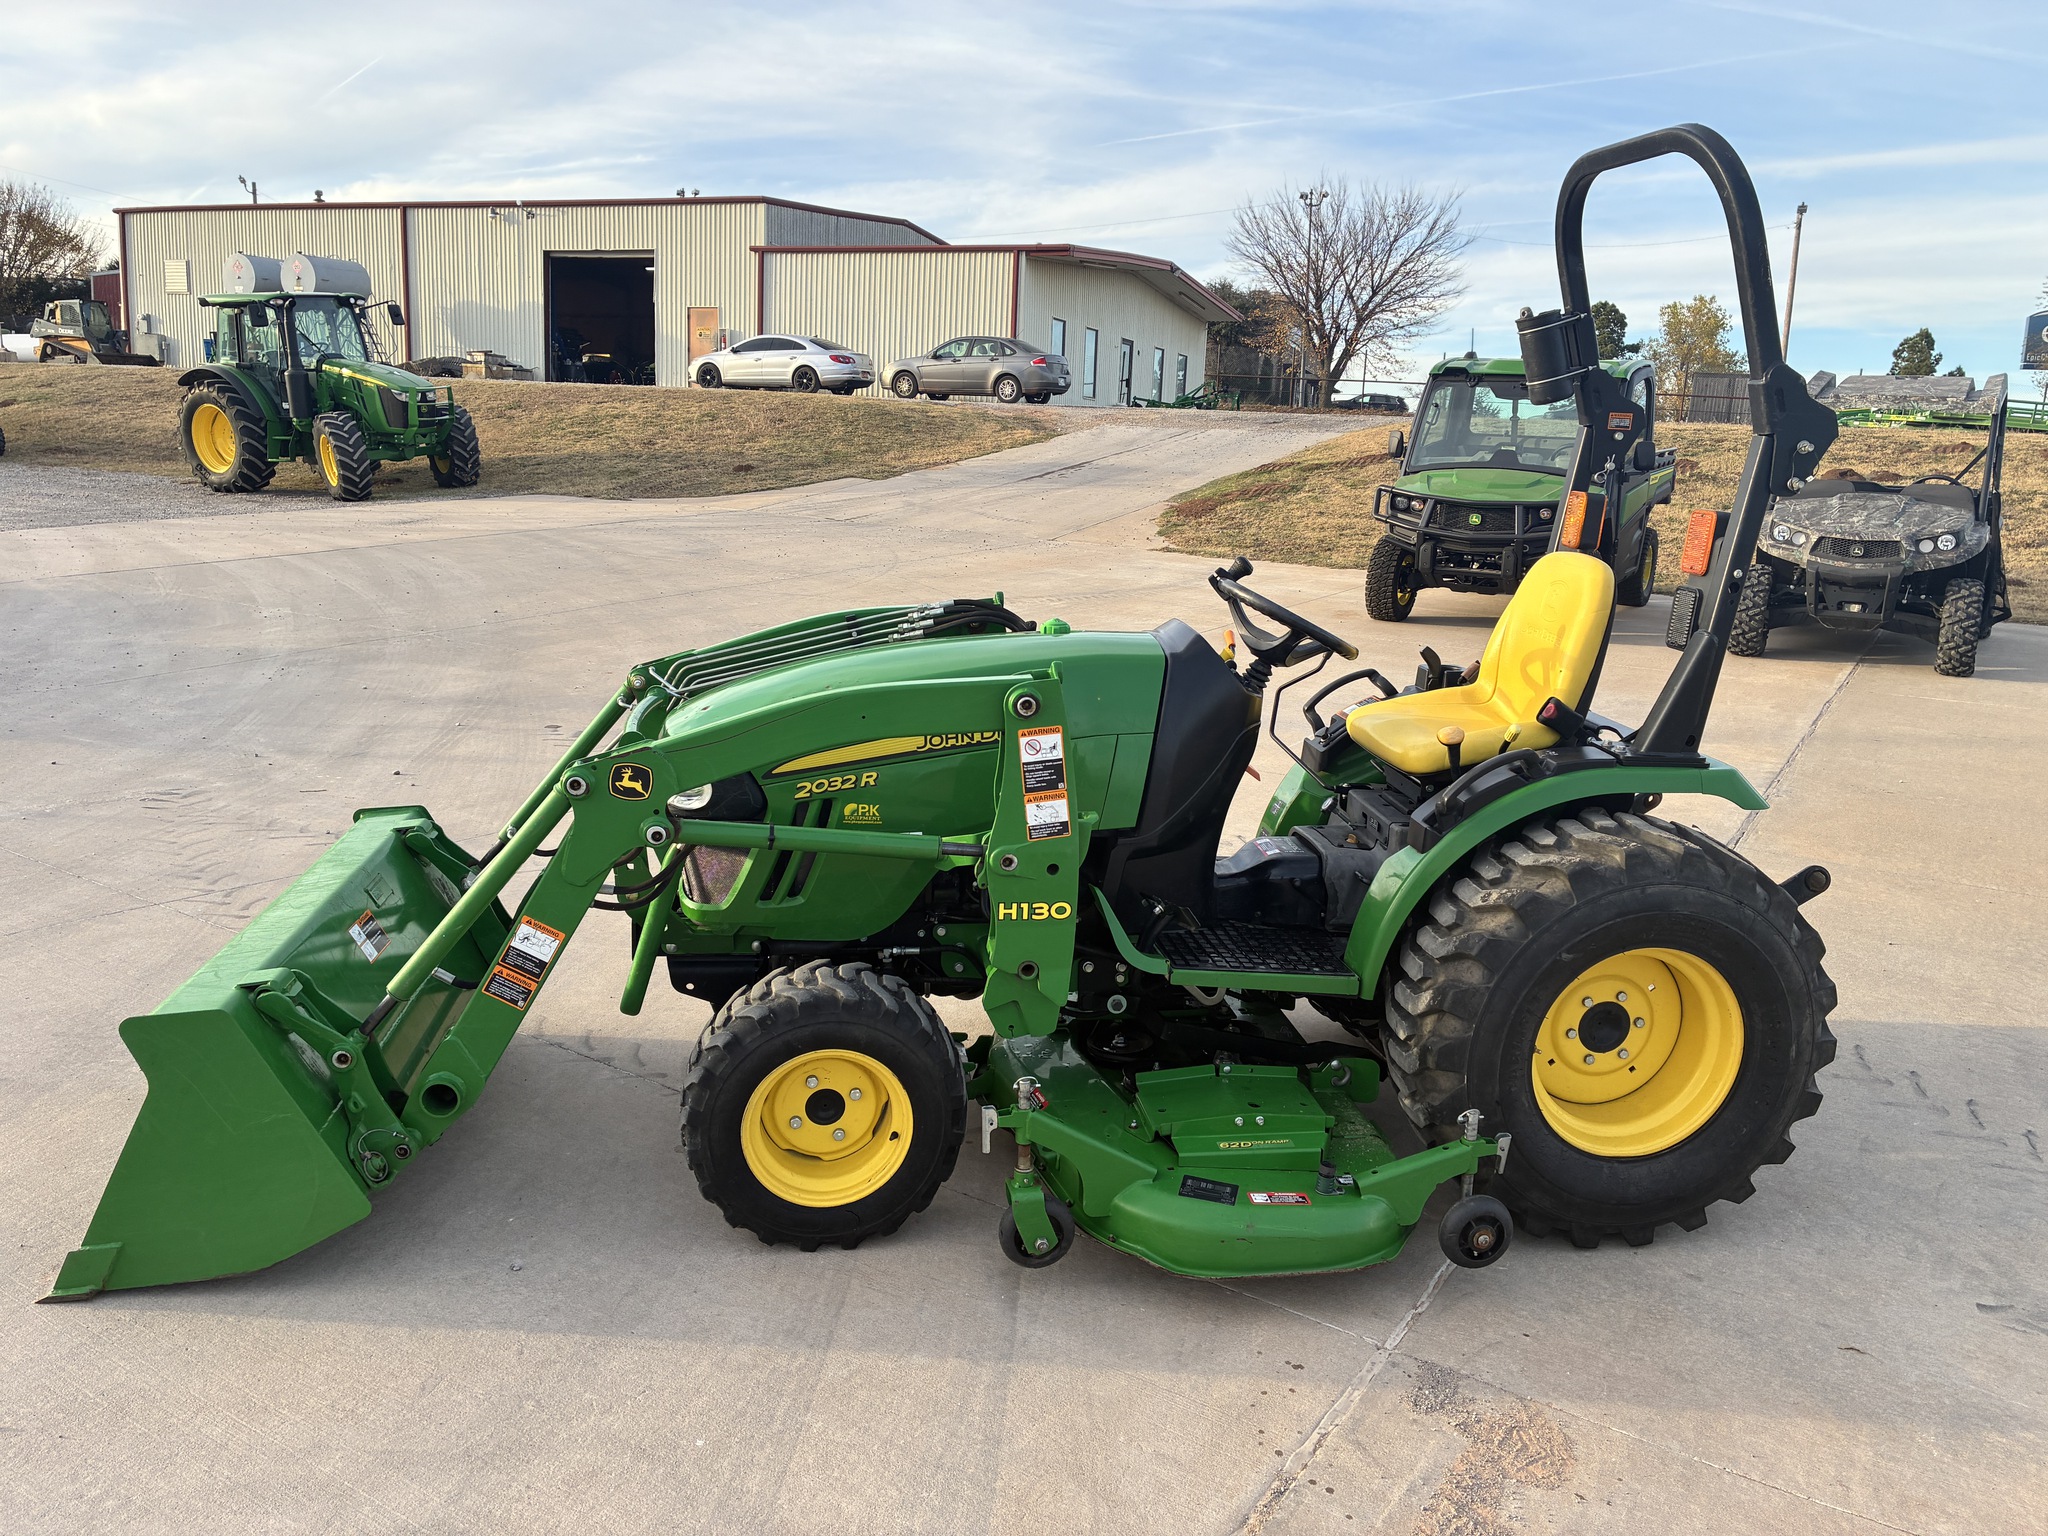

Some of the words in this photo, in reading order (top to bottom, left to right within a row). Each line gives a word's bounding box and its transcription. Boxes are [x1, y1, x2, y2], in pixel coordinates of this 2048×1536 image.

[1027, 726, 1061, 737] WARNING
[916, 734, 976, 752] JOHN
[980, 731, 1001, 743] D
[794, 774, 857, 799] 2032
[860, 771, 879, 787] R
[1032, 792, 1066, 803] WARNING
[858, 804, 880, 816] PK
[998, 901, 1073, 921] H130
[532, 921, 561, 938] WARNING
[505, 971, 533, 989] WARNING
[1219, 1141, 1252, 1149] 62D
